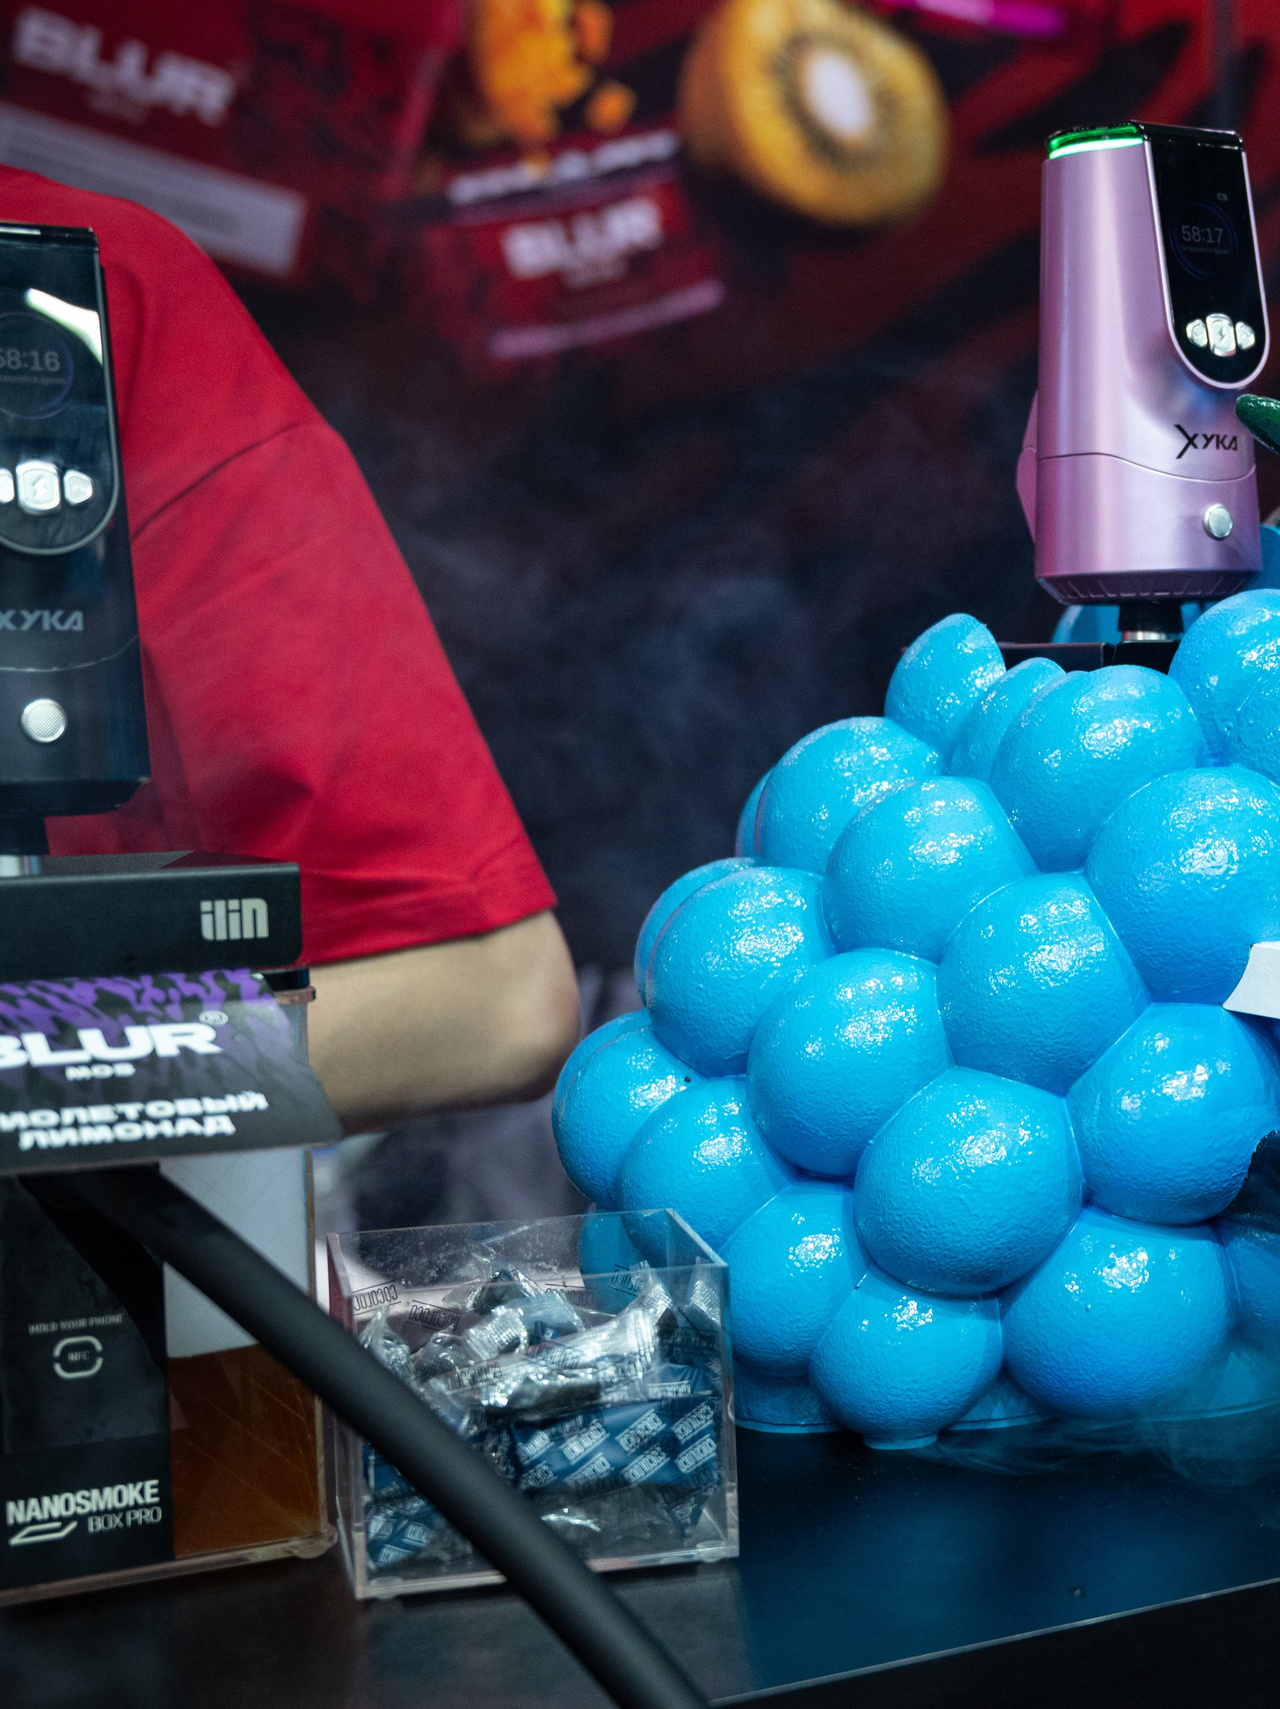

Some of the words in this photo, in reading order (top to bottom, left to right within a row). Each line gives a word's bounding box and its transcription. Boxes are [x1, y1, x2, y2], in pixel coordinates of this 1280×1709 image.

[1181, 225, 1223, 244] 58:17
[0, 1022, 223, 1070] BLUR
[0, 1090, 269, 1132] ИОЛЕТОВЫЙ
[18, 1114, 237, 1151] ЛИМОНАД
[6, 1479, 160, 1525] NANOSMOKE
[88, 1512, 124, 1533] BOX
[126, 1505, 162, 1528] PRO
